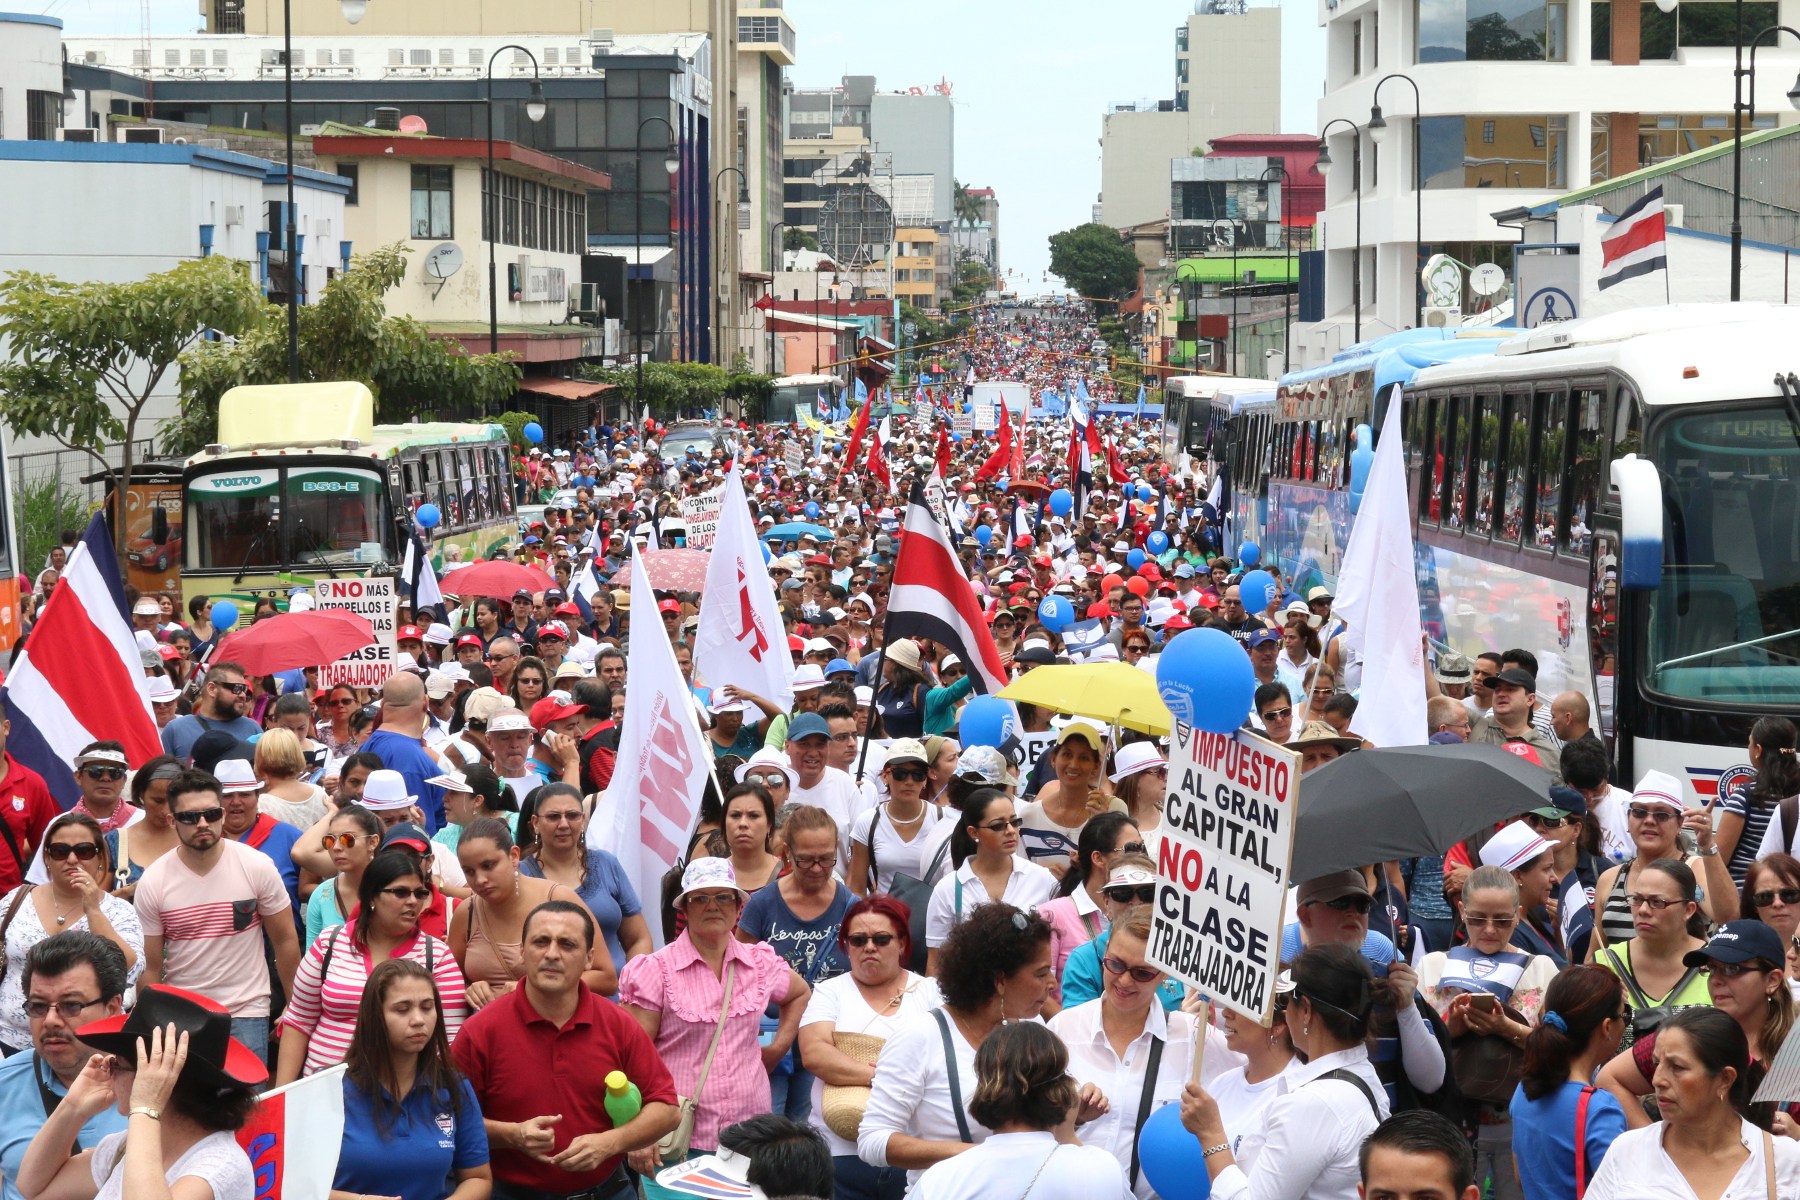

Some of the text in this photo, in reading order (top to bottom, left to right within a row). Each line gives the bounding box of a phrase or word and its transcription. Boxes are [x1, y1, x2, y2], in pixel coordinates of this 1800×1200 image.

[211, 476, 262, 488] VOLVO
[303, 481, 360, 492] B58-E
[690, 496, 718, 507] CONTRA
[692, 522, 716, 534] DE LOS
[332, 581, 389, 598] NO MÁS
[384, 601, 391, 613] E
[319, 663, 394, 687] TRABAJADORA
[1174, 681, 1194, 694] Lucha
[1192, 729, 1288, 802] IMPUESTO
[1180, 768, 1279, 834] AL GRAN
[1166, 792, 1282, 884] CAPITAL,
[1159, 836, 1251, 911] NO A LA
[1159, 884, 1269, 968] CLASE
[1151, 920, 1267, 1015] TRABAJADORA
